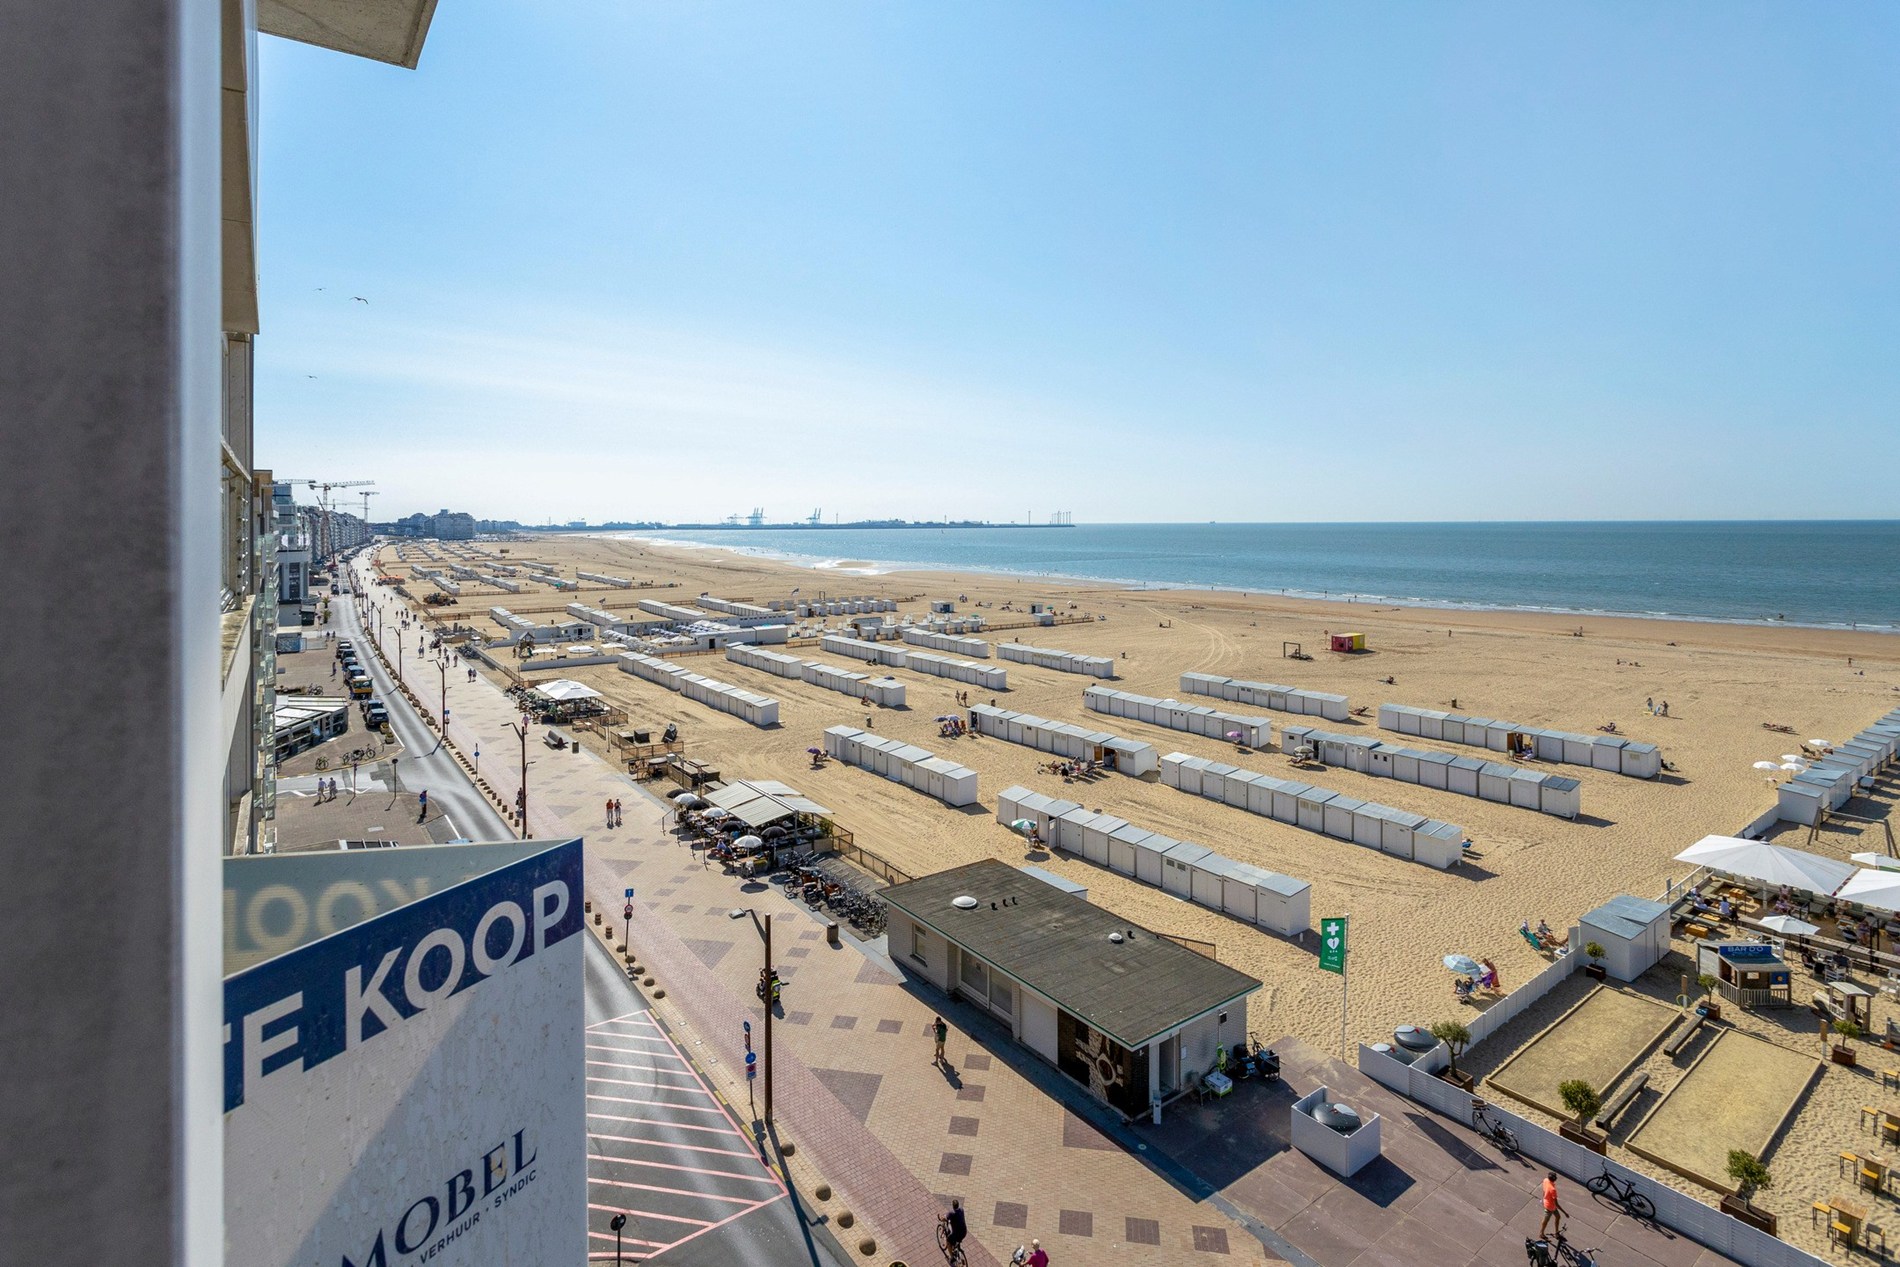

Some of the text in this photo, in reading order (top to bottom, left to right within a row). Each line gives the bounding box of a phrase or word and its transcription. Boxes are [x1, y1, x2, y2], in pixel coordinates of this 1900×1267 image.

[224, 879, 570, 1104] E KOOP
[420, 1169, 537, 1264] VERHUUR SYNDIC
